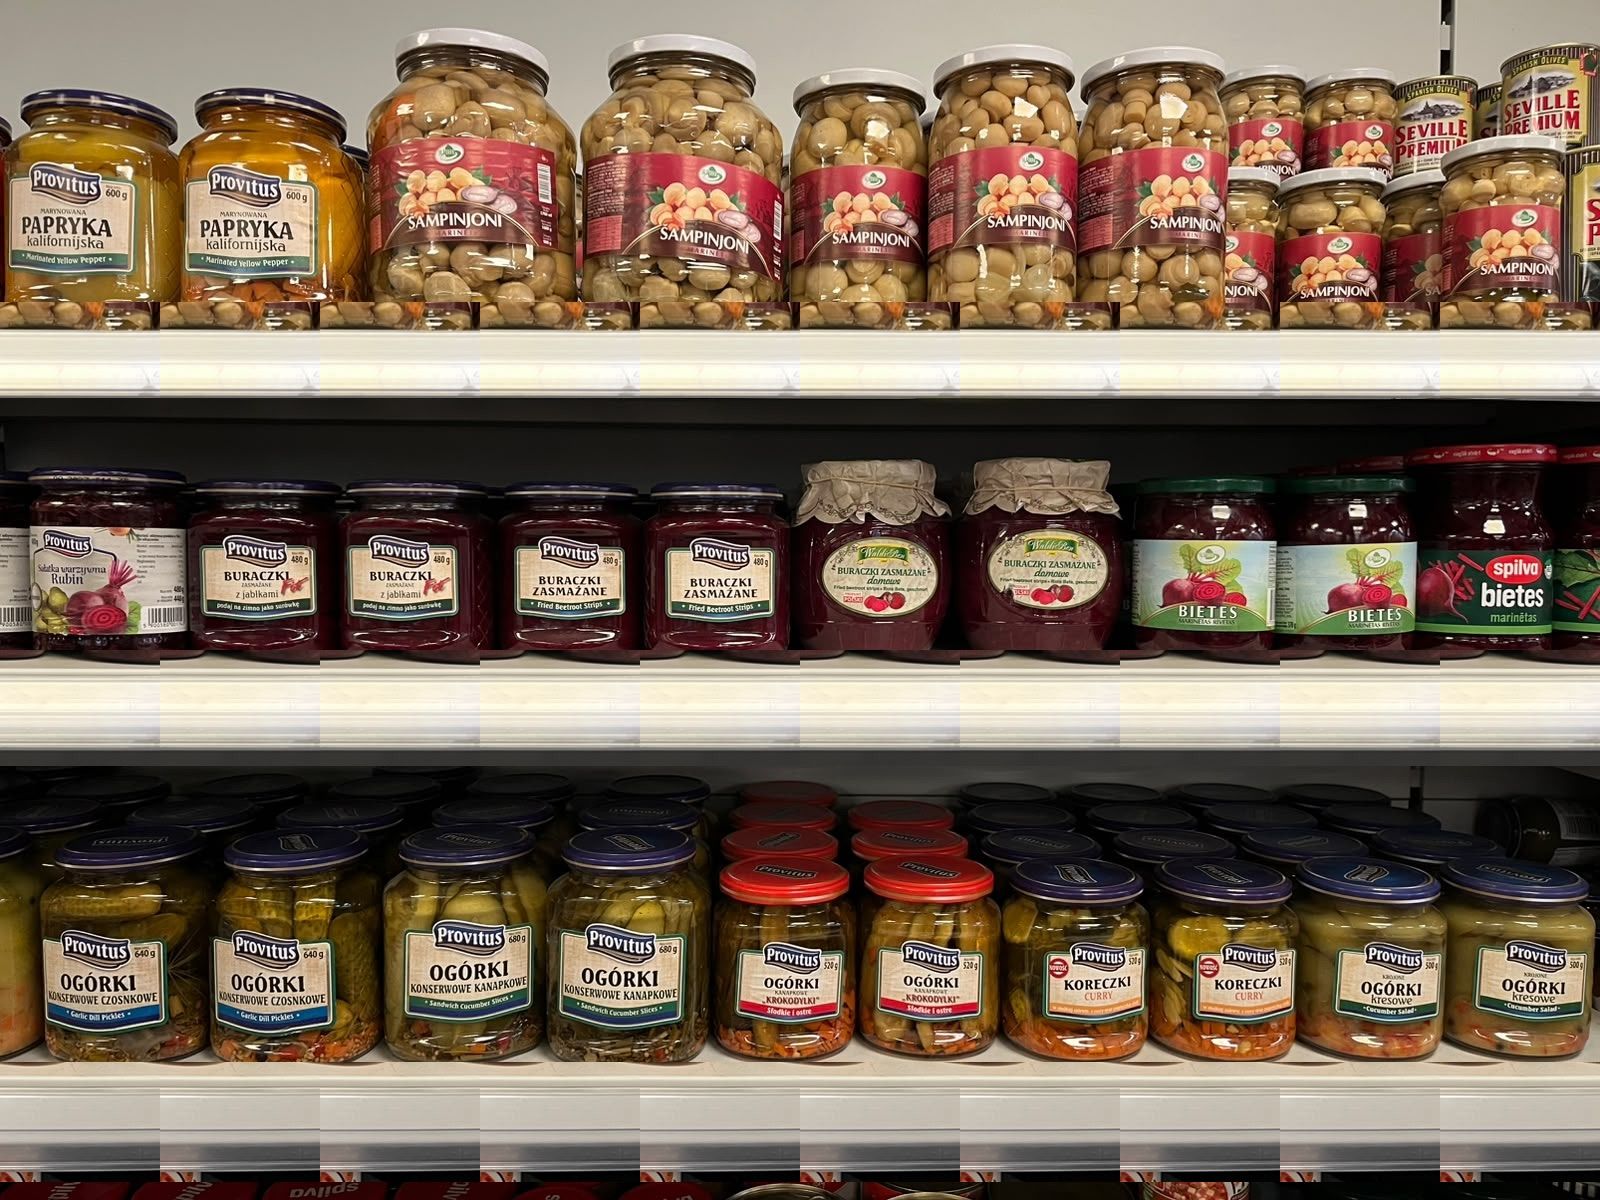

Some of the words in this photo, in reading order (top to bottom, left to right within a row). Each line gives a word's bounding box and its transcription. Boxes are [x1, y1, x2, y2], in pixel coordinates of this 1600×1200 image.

[1512, 58, 1538, 75] SPANISH
[1541, 56, 1566, 65] OLIVES
[1407, 86, 1434, 100] SPANISH
[1436, 85, 1458, 95] OLIVES
[1504, 89, 1580, 123] SEVILLE
[1395, 119, 1468, 145] SEVILLE
[33, 170, 98, 195] Provitus
[212, 173, 278, 198] Provitus
[105, 188, 121, 198] 600
[286, 191, 301, 200] 600
[40, 207, 87, 215] MARYNOWANA
[22, 216, 112, 237] PAPRYKA
[200, 219, 294, 240] PAPRYKA
[27, 235, 104, 250] kalifornijska
[206, 238, 286, 253] kalifornijska
[660, 225, 749, 254] ŠAMPINJONI
[26, 252, 55, 264] Marinated
[57, 256, 78, 265] Yellow
[80, 255, 106, 264] Pepper
[205, 255, 237, 267] Marinated
[238, 259, 260, 268] Yellow
[263, 258, 288, 267] Pepper
[45, 534, 89, 551] Provitus
[228, 542, 284, 560] Provitus
[373, 542, 427, 560] Provitus
[543, 542, 597, 560] Provitus
[694, 544, 748, 562] Provitus
[291, 555, 303, 563] 480
[753, 557, 764, 566] 480
[1004, 559, 1047, 568] BURACZKI
[838, 567, 879, 576] BURACZKI
[1034, 568, 1069, 577] domowe
[1493, 559, 1539, 578] spilva
[51, 572, 83, 585] Rubin
[224, 571, 289, 581] BURACZKI
[370, 571, 432, 581] BURACZKI
[539, 576, 601, 585] BURACZKI
[690, 578, 752, 587] BURACZKI
[867, 576, 901, 585] domowe
[532, 586, 607, 596] ZASMAŻANE
[684, 587, 758, 598] ZASMAŻANE
[1481, 582, 1544, 608] bietes
[217, 602, 233, 610] podaj
[261, 603, 274, 612] jako
[537, 601, 554, 609] Fried
[555, 602, 583, 611] Beetroot
[584, 601, 603, 609] Strips
[688, 604, 705, 612] Fried
[706, 605, 734, 613] Beetroot
[1179, 604, 1238, 619] BIETES
[1348, 608, 1401, 622] BIETES
[1490, 612, 1537, 623] marinētas
[759, 866, 812, 877] Provitus
[904, 862, 956, 877] Provitus
[438, 927, 502, 946] Provitus
[508, 935, 521, 943] 680
[590, 930, 652, 954] Provitus
[65, 936, 127, 959] Provitus
[134, 949, 149, 958] 640
[235, 936, 296, 959] Provitus
[659, 945, 671, 953] 680
[303, 951, 318, 959] 640
[767, 948, 818, 967] Provitus
[905, 947, 958, 966] Provitus
[1074, 948, 1124, 964] Provitus
[1225, 948, 1275, 964] Provitus
[1368, 947, 1421, 966] Provitus
[1509, 945, 1564, 965] Provitus
[429, 960, 509, 981] OGÓRKI
[823, 962, 833, 970] 520
[60, 972, 136, 992] OGÓRKI
[231, 973, 306, 993] OGÓRKI
[581, 966, 658, 988] OGÓRKI
[764, 976, 819, 990] OGÓRKI
[903, 974, 959, 988] OGÓRKI
[1064, 976, 1131, 990] KORECZKI
[1214, 976, 1282, 990] KORECZKI
[410, 983, 471, 994] KONSERWOWE
[474, 976, 527, 993] KANAPKOWE
[564, 983, 621, 1000] KONSERWOWE
[623, 988, 678, 1001] KANAPKOWE
[1361, 981, 1422, 996] OGÓRKI
[1502, 978, 1566, 995] OGÓRKI
[48, 991, 99, 1005] KONSERWOWE
[101, 992, 158, 1005] CZOSNKOWE
[219, 991, 269, 1006] KONSERWOWE
[271, 994, 326, 1006] CZOSNKOWE
[429, 999, 458, 1010] Sandwich
[460, 1000, 490, 1010] Cucumber
[491, 995, 509, 1005] Slices
[1084, 991, 1113, 1001] CURRY
[1234, 991, 1264, 1001] CURRY
[1371, 994, 1413, 1005] kresowe
[1512, 992, 1556, 1003] kresowe
[581, 1002, 608, 1015] Sandwich
[609, 1007, 639, 1017] Cucumber
[640, 1005, 658, 1015] Slices
[1366, 1006, 1397, 1014] Cucumber
[1507, 1003, 1539, 1012] Cucumber
[70, 1011, 88, 1020] Garlic
[89, 1013, 100, 1021] Dill
[101, 1012, 125, 1020] Pickles
[240, 1012, 257, 1021] Garlic
[258, 1014, 270, 1022] Dill
[271, 1013, 294, 1021] Pickles
